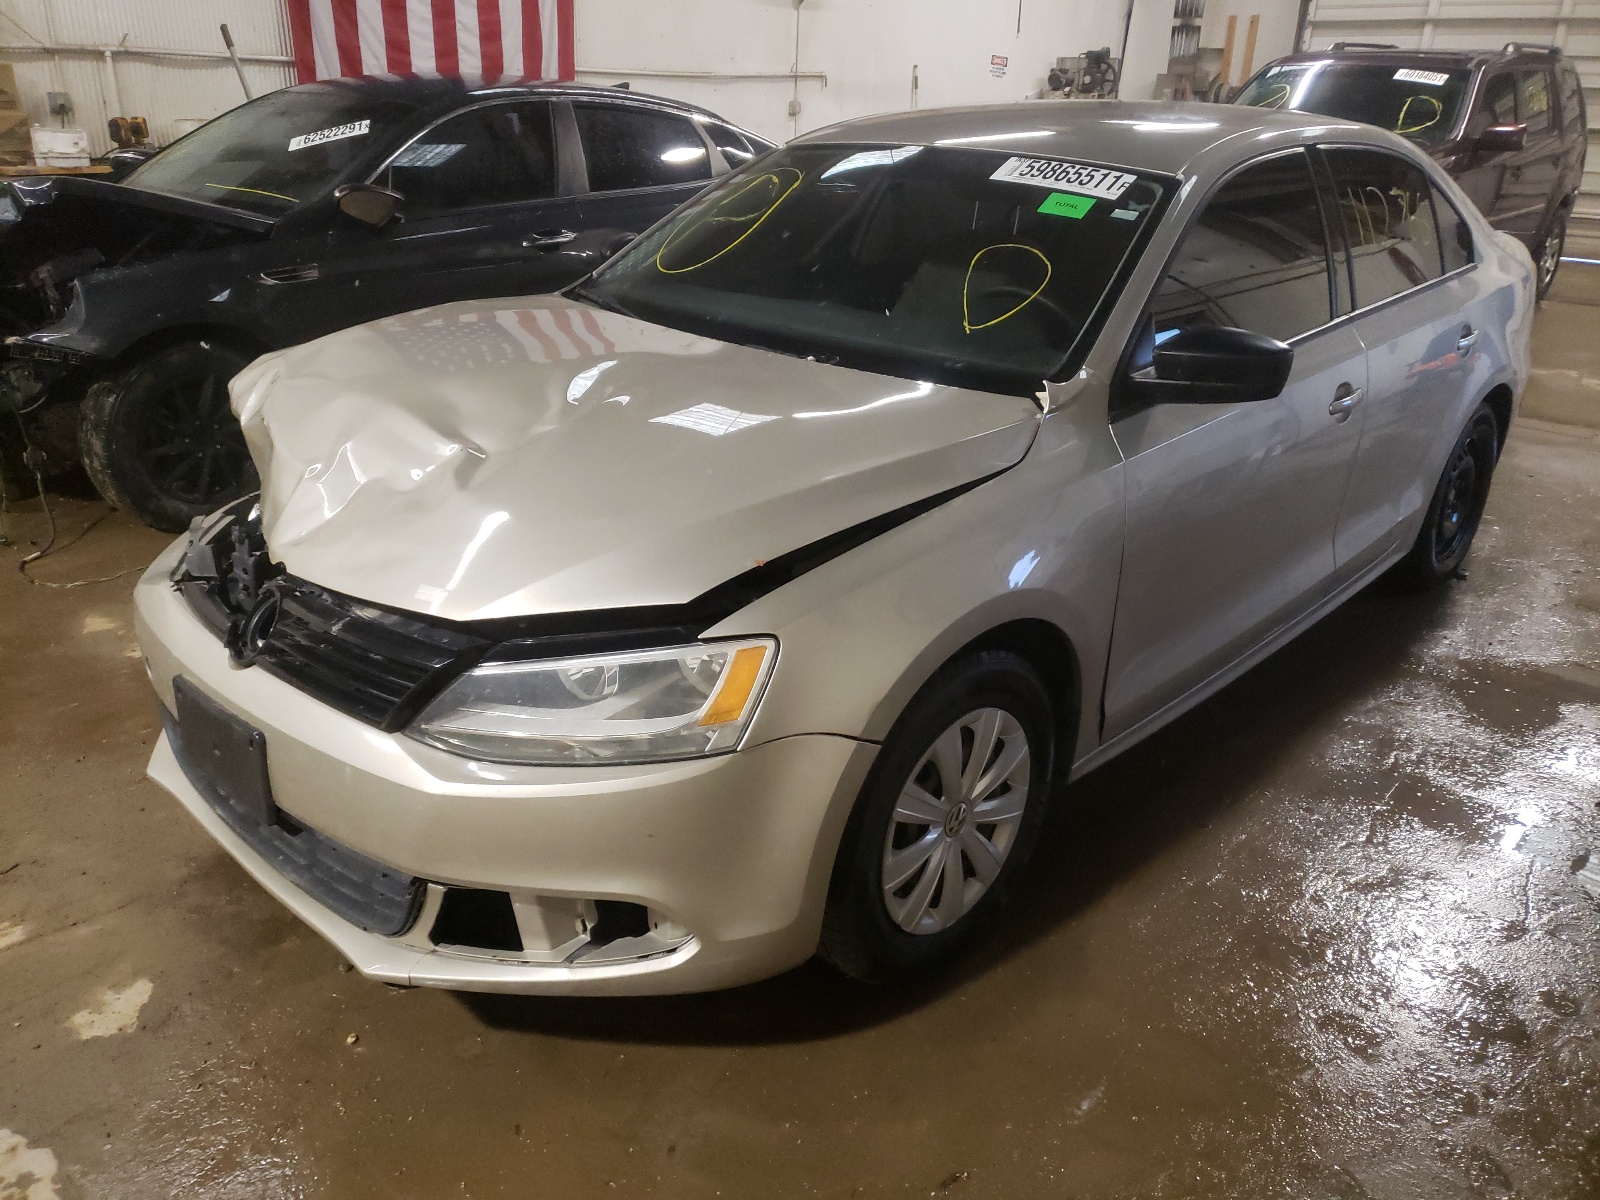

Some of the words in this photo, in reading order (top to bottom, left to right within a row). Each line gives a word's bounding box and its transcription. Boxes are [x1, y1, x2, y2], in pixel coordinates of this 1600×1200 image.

[303, 122, 363, 145] 62522291
[1019, 160, 1124, 191] 59865511
[1055, 201, 1078, 210] TOTAL
